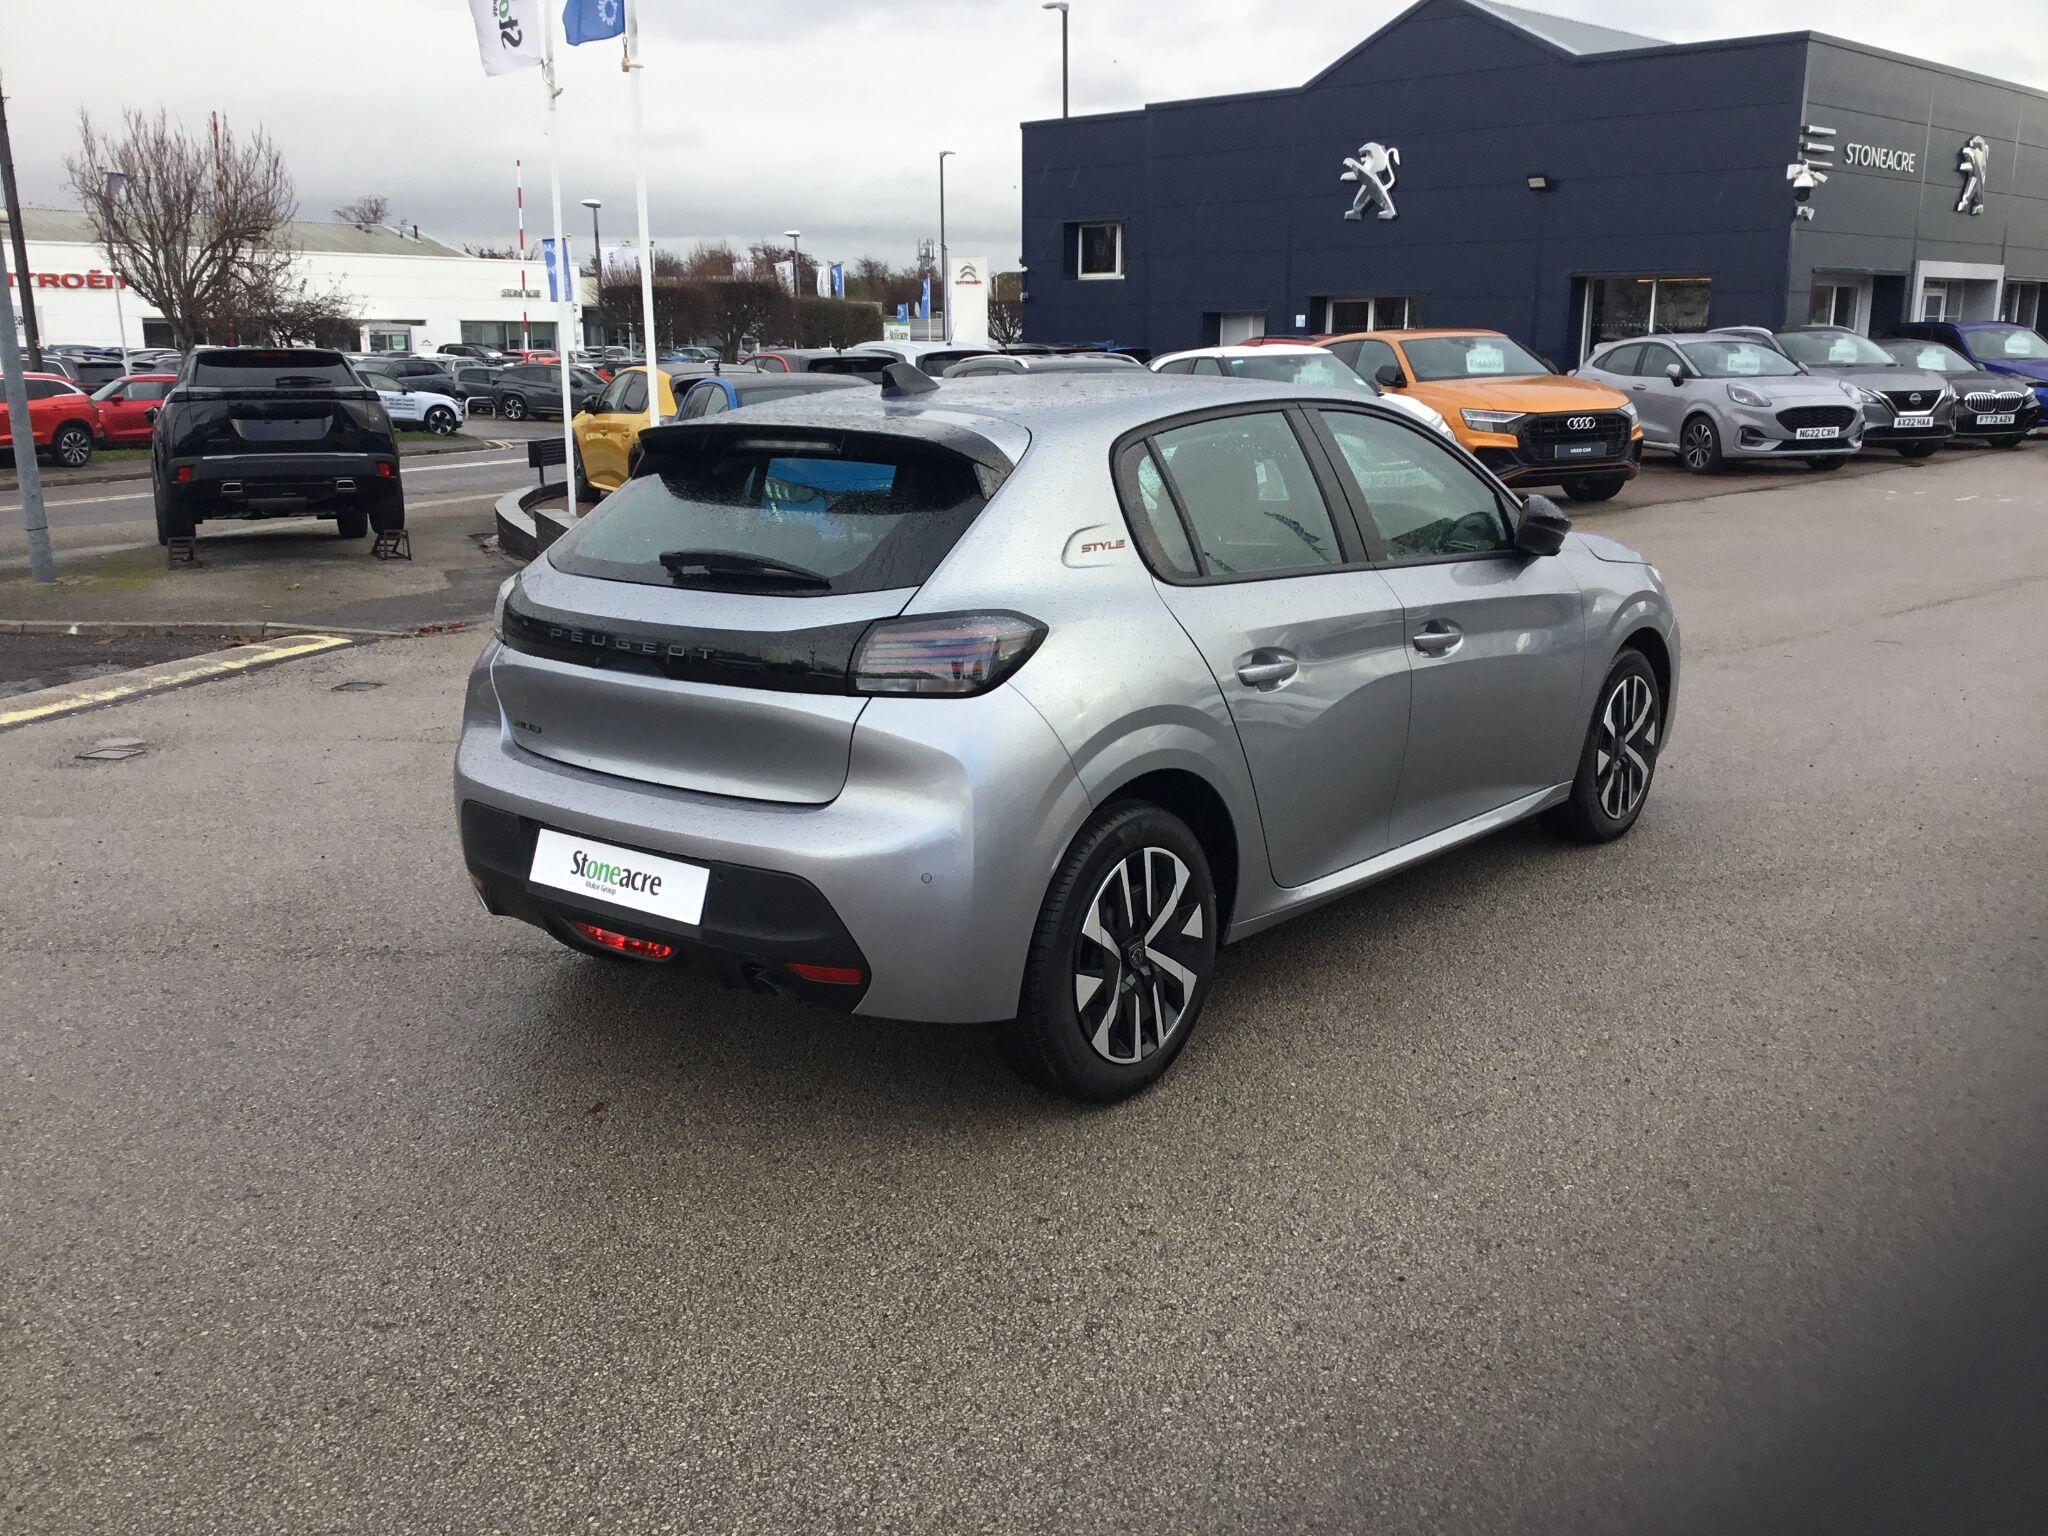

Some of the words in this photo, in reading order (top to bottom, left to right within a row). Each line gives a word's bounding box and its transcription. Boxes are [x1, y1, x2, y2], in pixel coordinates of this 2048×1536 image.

[1845, 143, 1916, 172] STONEACRE
[1897, 418, 1916, 427] AX22
[1917, 418, 1931, 426] HAA
[1800, 429, 1820, 438] NG22
[1821, 428, 1836, 437] CXH
[1081, 540, 1126, 553] STYLE
[550, 628, 714, 660] PEUGEOT
[570, 850, 662, 896] Stoneacre
[585, 880, 600, 891] Motor
[600, 884, 617, 896] Group
